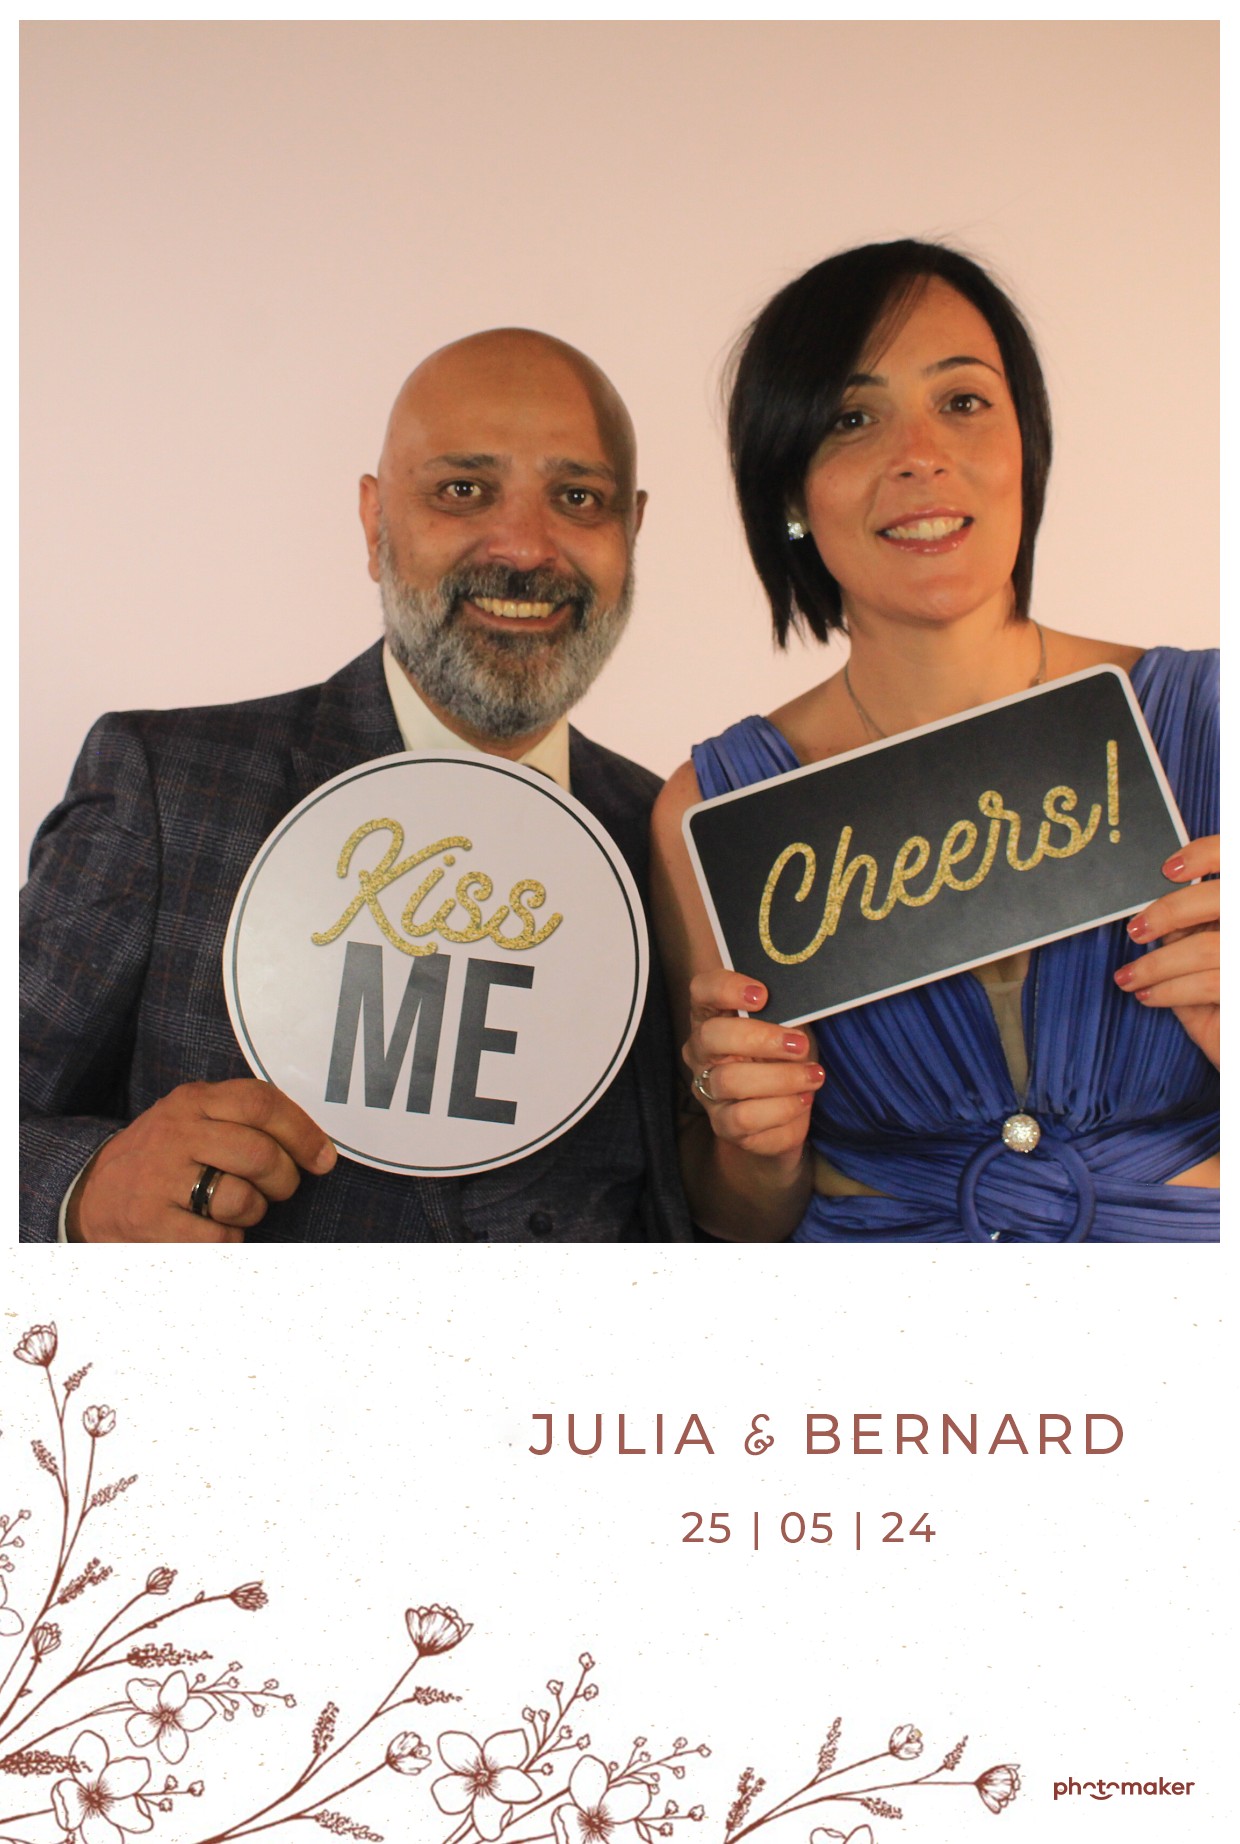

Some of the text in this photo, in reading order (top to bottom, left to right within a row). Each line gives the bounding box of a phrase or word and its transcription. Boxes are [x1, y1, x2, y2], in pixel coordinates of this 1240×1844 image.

[311, 816, 564, 957] Kiss
[758, 739, 1120, 965] Cheers!
[324, 940, 535, 1125] ME
